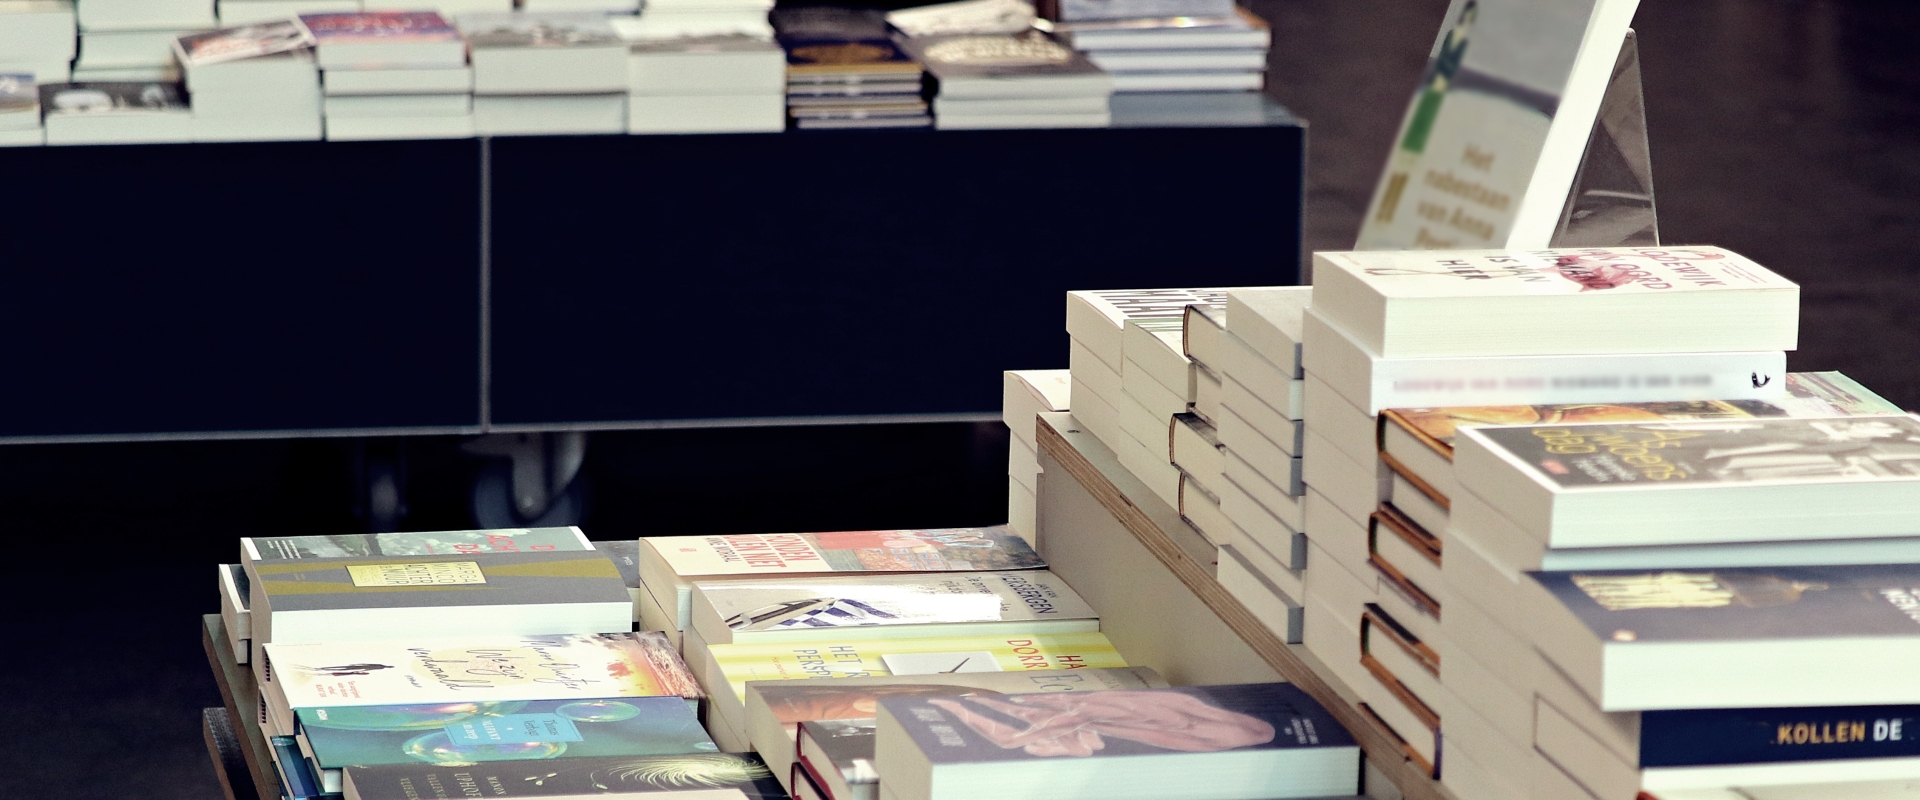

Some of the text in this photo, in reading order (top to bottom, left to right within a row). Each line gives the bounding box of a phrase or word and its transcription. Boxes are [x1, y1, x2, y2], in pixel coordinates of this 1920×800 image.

[1436, 259, 1493, 281] HIER
[1630, 248, 1728, 287] LODEWIJK
[739, 552, 788, 568] NIET
[430, 563, 457, 584] MINCO
[457, 562, 479, 583] MARGA
[828, 645, 863, 664] HET
[407, 647, 495, 691] verdwaald
[466, 664, 528, 681] zijn
[1776, 717, 1904, 745] KOLLEN DE
